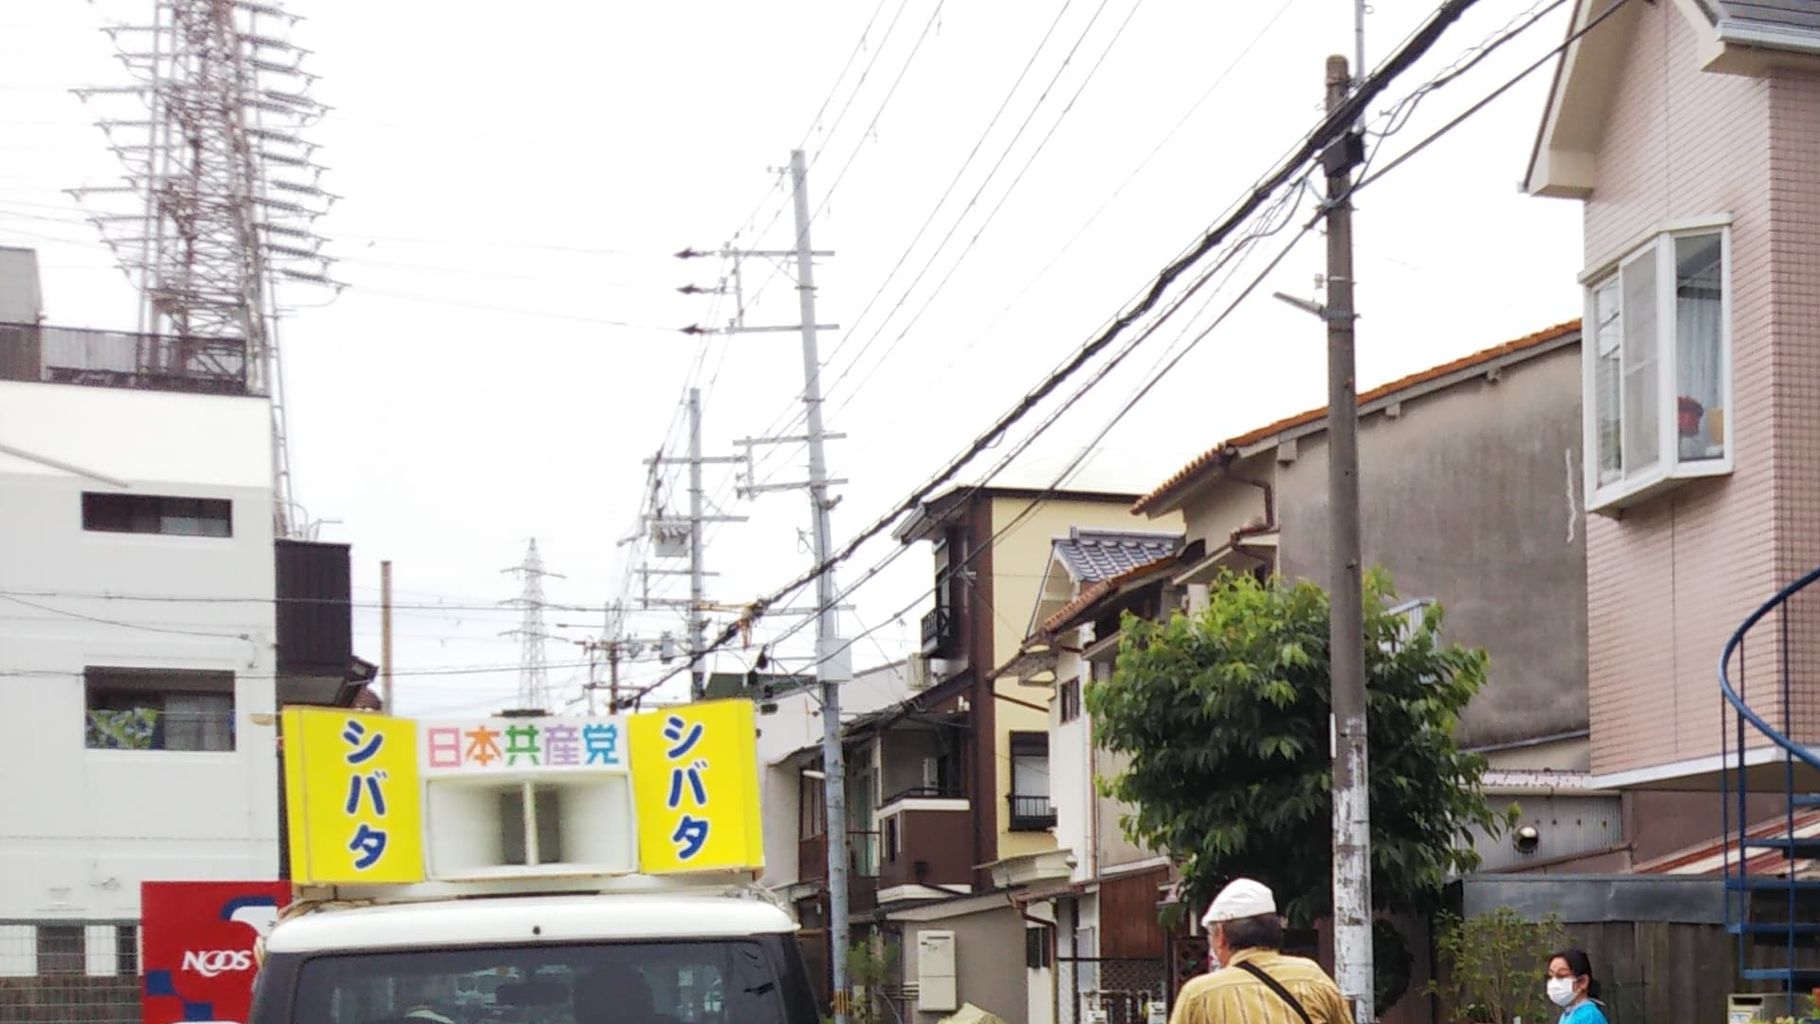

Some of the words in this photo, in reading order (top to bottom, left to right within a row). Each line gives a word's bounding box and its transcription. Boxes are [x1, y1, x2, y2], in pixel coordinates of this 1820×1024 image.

[342, 719, 389, 870] シバタ
[427, 724, 620, 768] 日本共産党
[663, 716, 711, 860] シバタ
